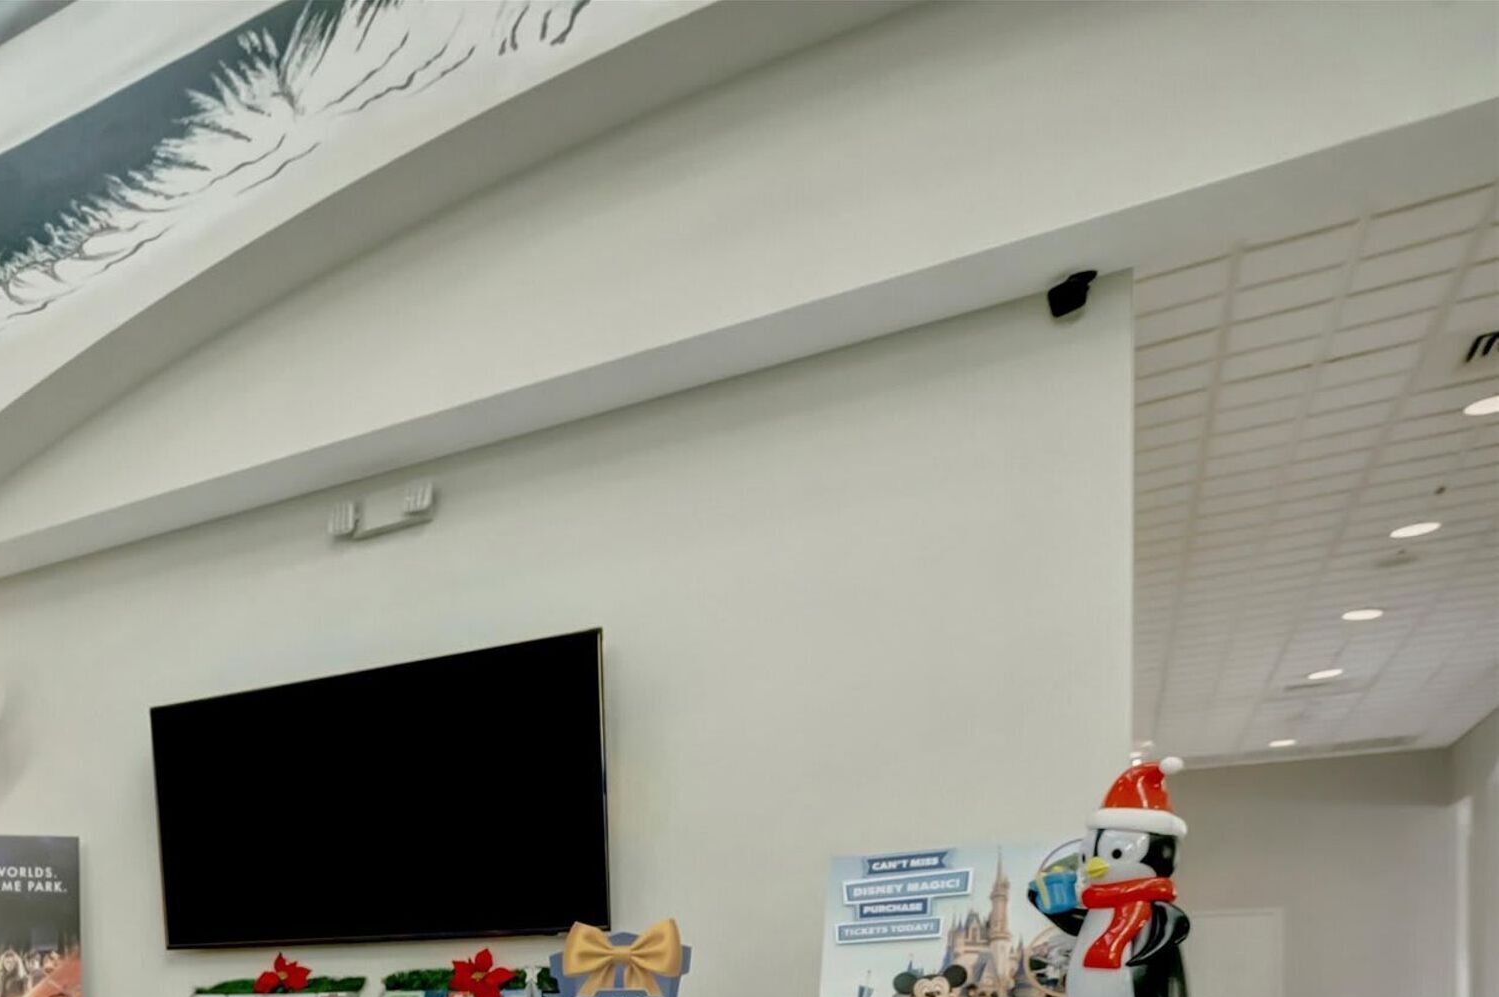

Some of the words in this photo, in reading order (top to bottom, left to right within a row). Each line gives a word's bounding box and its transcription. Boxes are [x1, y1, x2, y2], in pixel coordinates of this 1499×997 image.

[872, 859, 908, 871] CAN'T
[910, 857, 939, 868] MISS
[27, 881, 67, 892] PARK.
[853, 884, 904, 897] DISNEY
[907, 879, 960, 892] MAGIC!
[863, 902, 924, 914] PURCHASE
[844, 925, 889, 937] TICKETS
[891, 922, 934, 934] TODAY!
